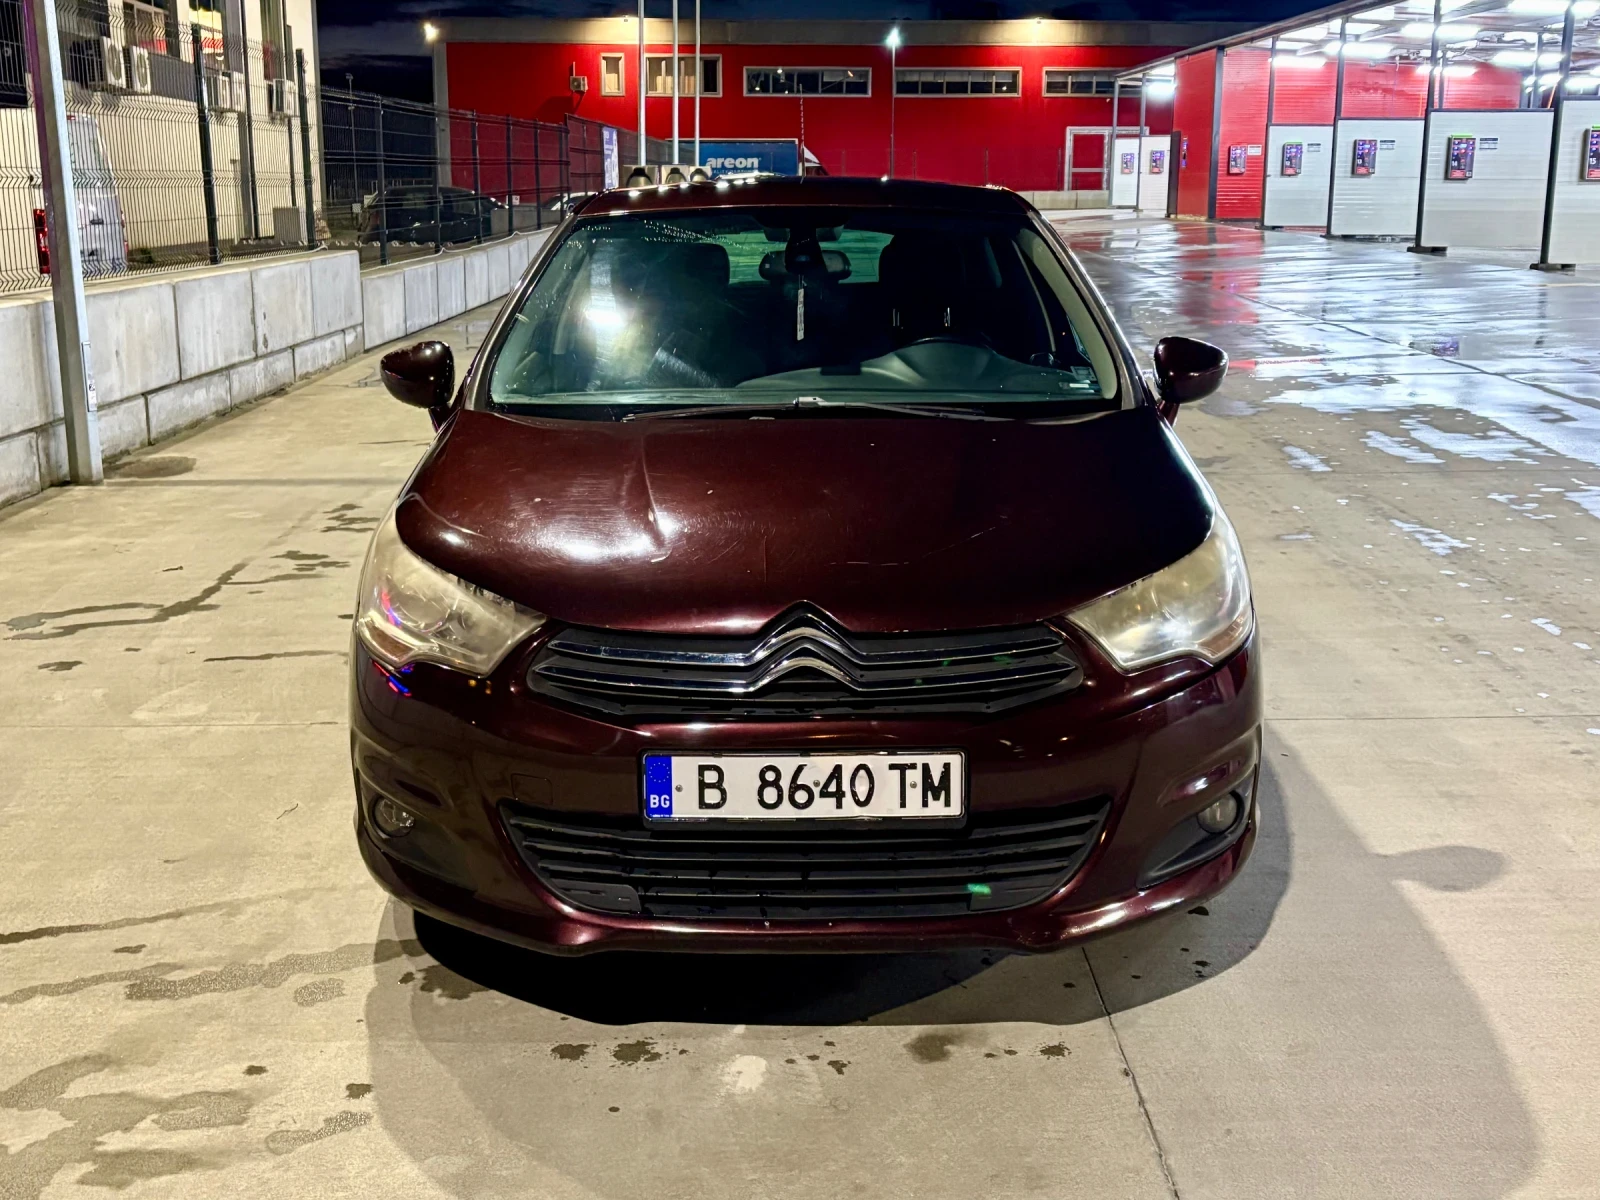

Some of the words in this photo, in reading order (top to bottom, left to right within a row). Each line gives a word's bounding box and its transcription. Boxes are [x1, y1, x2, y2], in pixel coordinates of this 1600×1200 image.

[705, 157, 759, 168] areon
[697, 763, 728, 810] B
[757, 763, 875, 810] 8640
[888, 762, 951, 809] TM
[649, 794, 670, 809] BG
